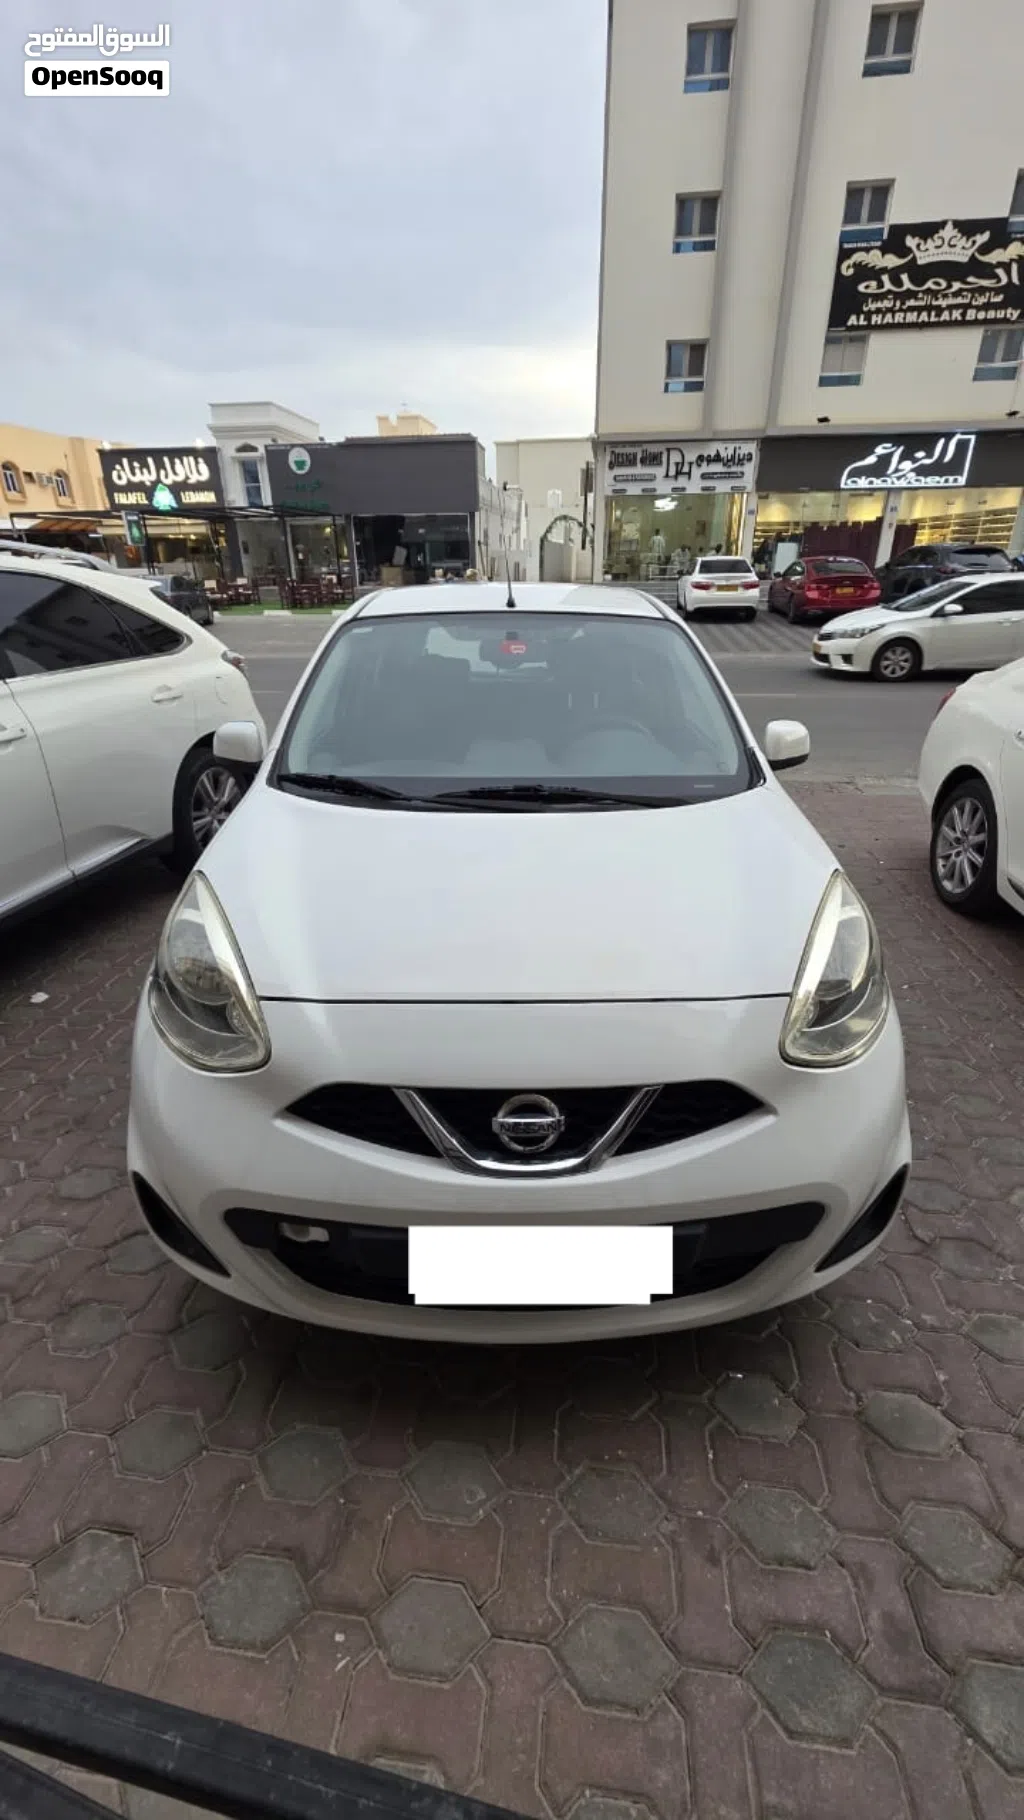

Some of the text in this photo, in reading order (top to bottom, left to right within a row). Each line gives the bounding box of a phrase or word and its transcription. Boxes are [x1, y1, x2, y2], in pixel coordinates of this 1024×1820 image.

[847, 307, 1021, 327] AL HARMALAK Beauty
[695, 446, 753, 468] ديزاين هوم
[842, 433, 962, 478] النواعم
[112, 456, 210, 486] فلافل لبنان
